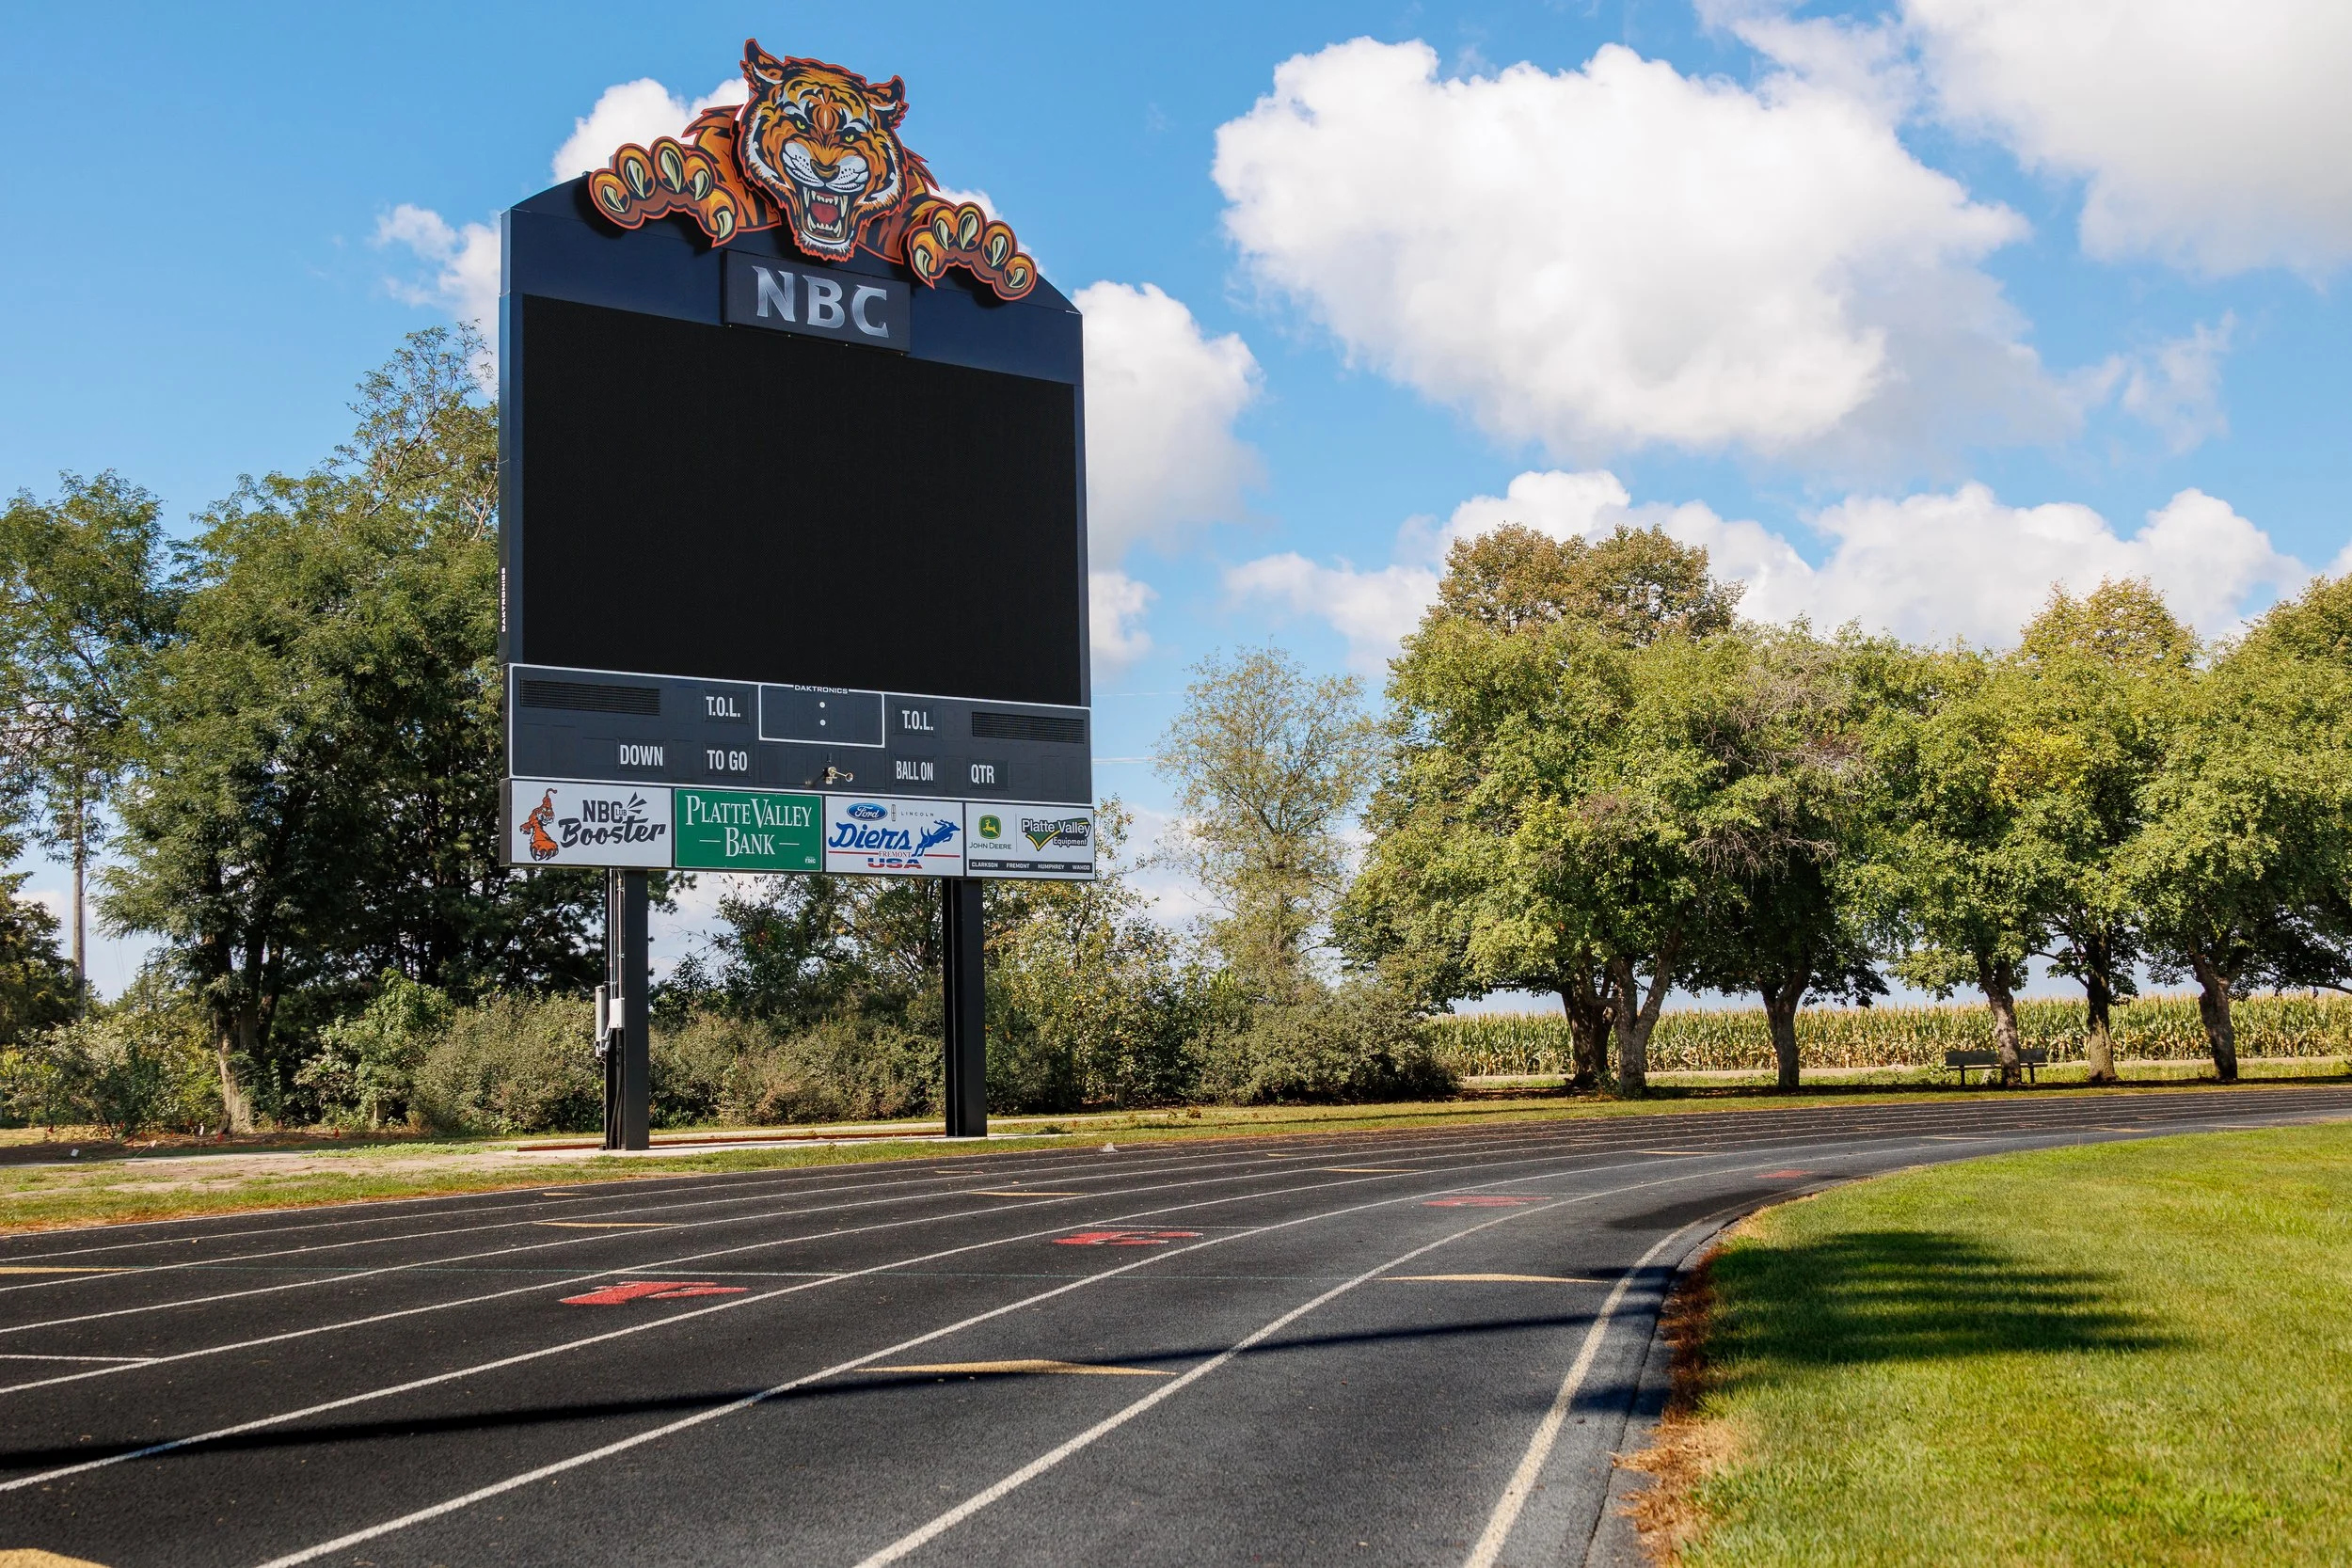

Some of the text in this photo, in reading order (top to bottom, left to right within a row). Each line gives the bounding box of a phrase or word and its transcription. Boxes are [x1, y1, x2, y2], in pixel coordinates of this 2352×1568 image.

[751, 265, 890, 339] NBC
[794, 684, 849, 694] DAKTRONICS
[706, 696, 741, 718] T.O.L.
[901, 710, 934, 731] T.O.L.
[619, 744, 664, 767] DOWN
[707, 750, 748, 772] TO GO
[896, 760, 934, 782] BALL ON
[970, 764, 995, 784] QTR
[582, 800, 624, 824] NBC
[854, 805, 880, 818] Ford
[558, 815, 666, 848] Booster
[828, 822, 913, 850] Diers
[1022, 819, 1091, 836] Platte Valley
[724, 827, 776, 857] BANK
[1053, 836, 1088, 847] Equipment
[867, 857, 923, 869] USA
